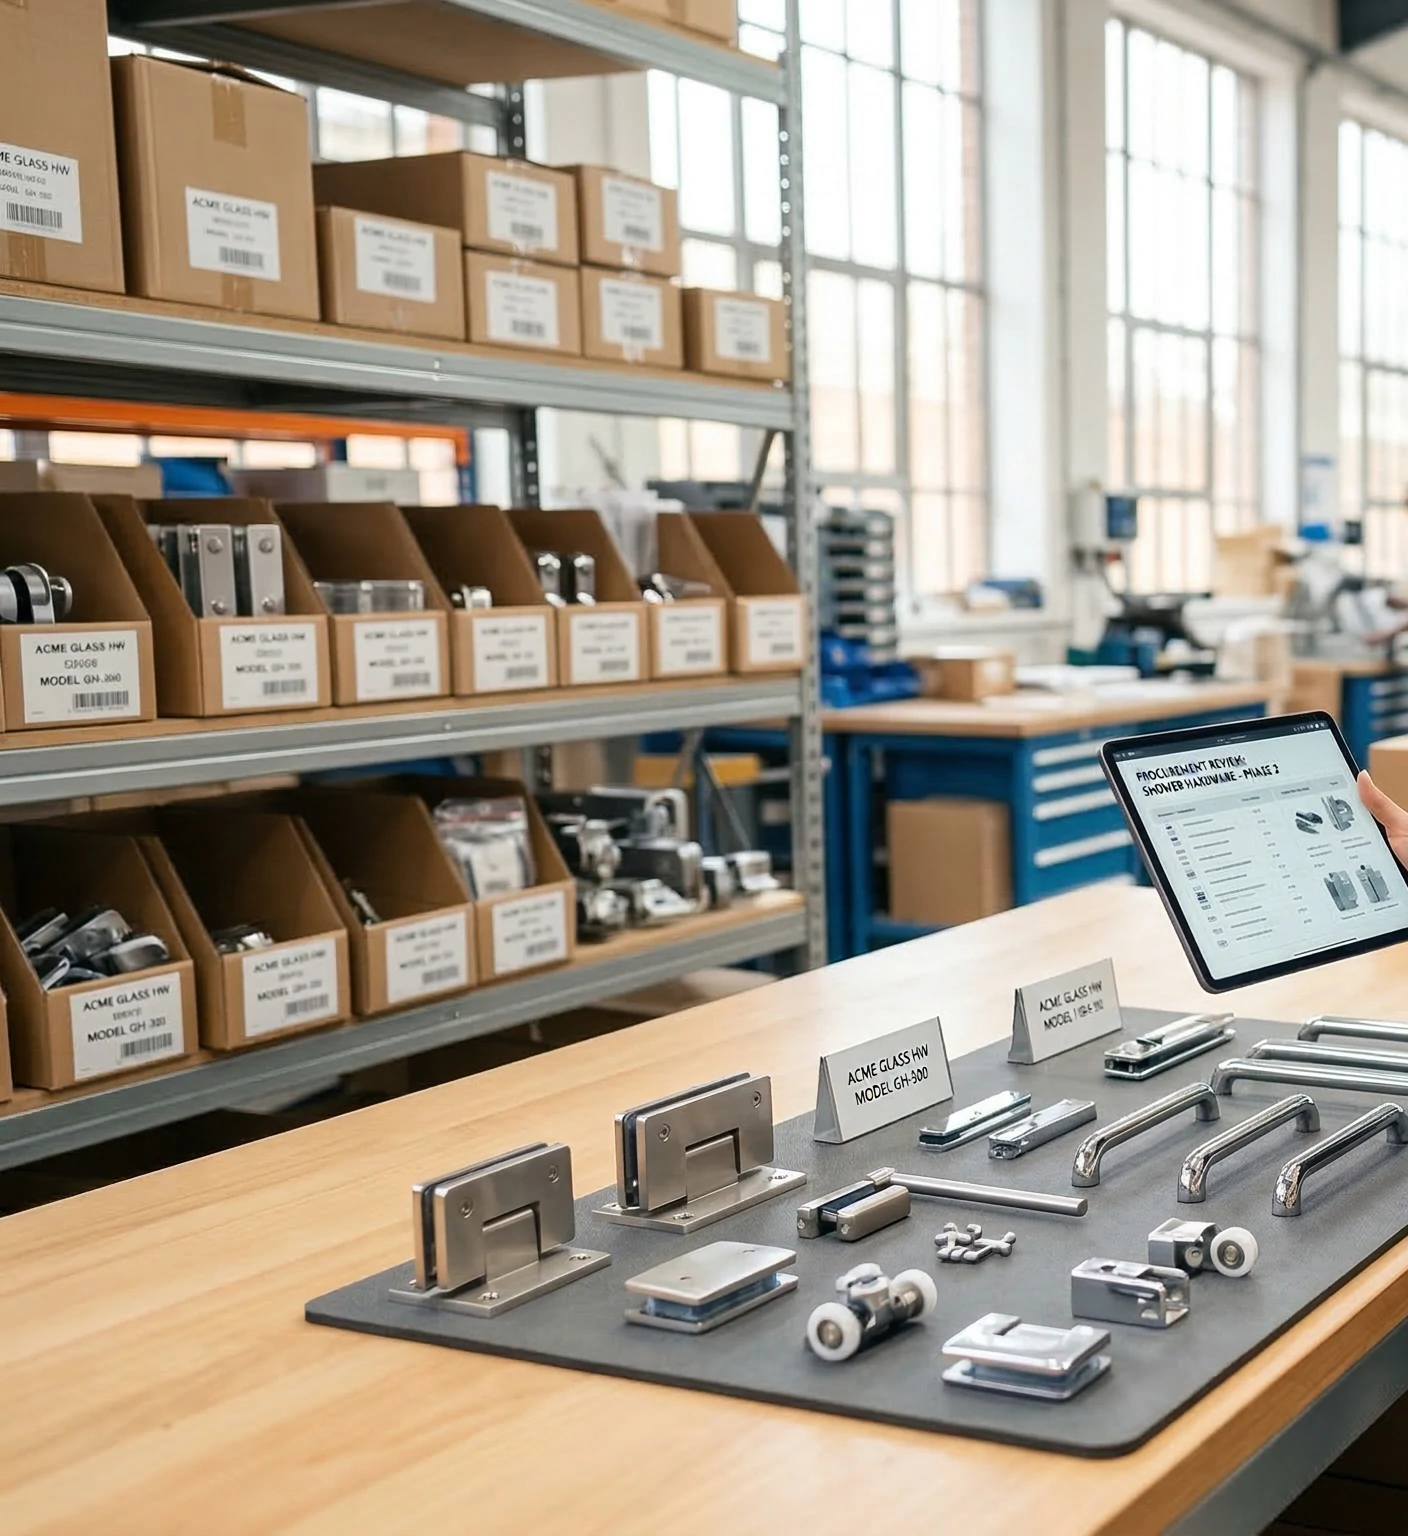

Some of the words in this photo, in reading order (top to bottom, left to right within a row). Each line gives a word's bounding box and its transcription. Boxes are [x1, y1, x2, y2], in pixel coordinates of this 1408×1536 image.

[14, 155, 49, 172] GLASS
[51, 163, 71, 176] HW
[35, 643, 67, 654] ACME
[70, 642, 105, 654] GLASS
[40, 675, 80, 687] MODEL
[83, 996, 114, 1012] ACME
[116, 988, 151, 1005] GLASS
[87, 1025, 127, 1043] MODEL
[848, 1062, 878, 1086] ACME
[879, 1050, 911, 1073] GLASS
[911, 1043, 928, 1063] HW
[855, 1081, 893, 1106] MODEL
